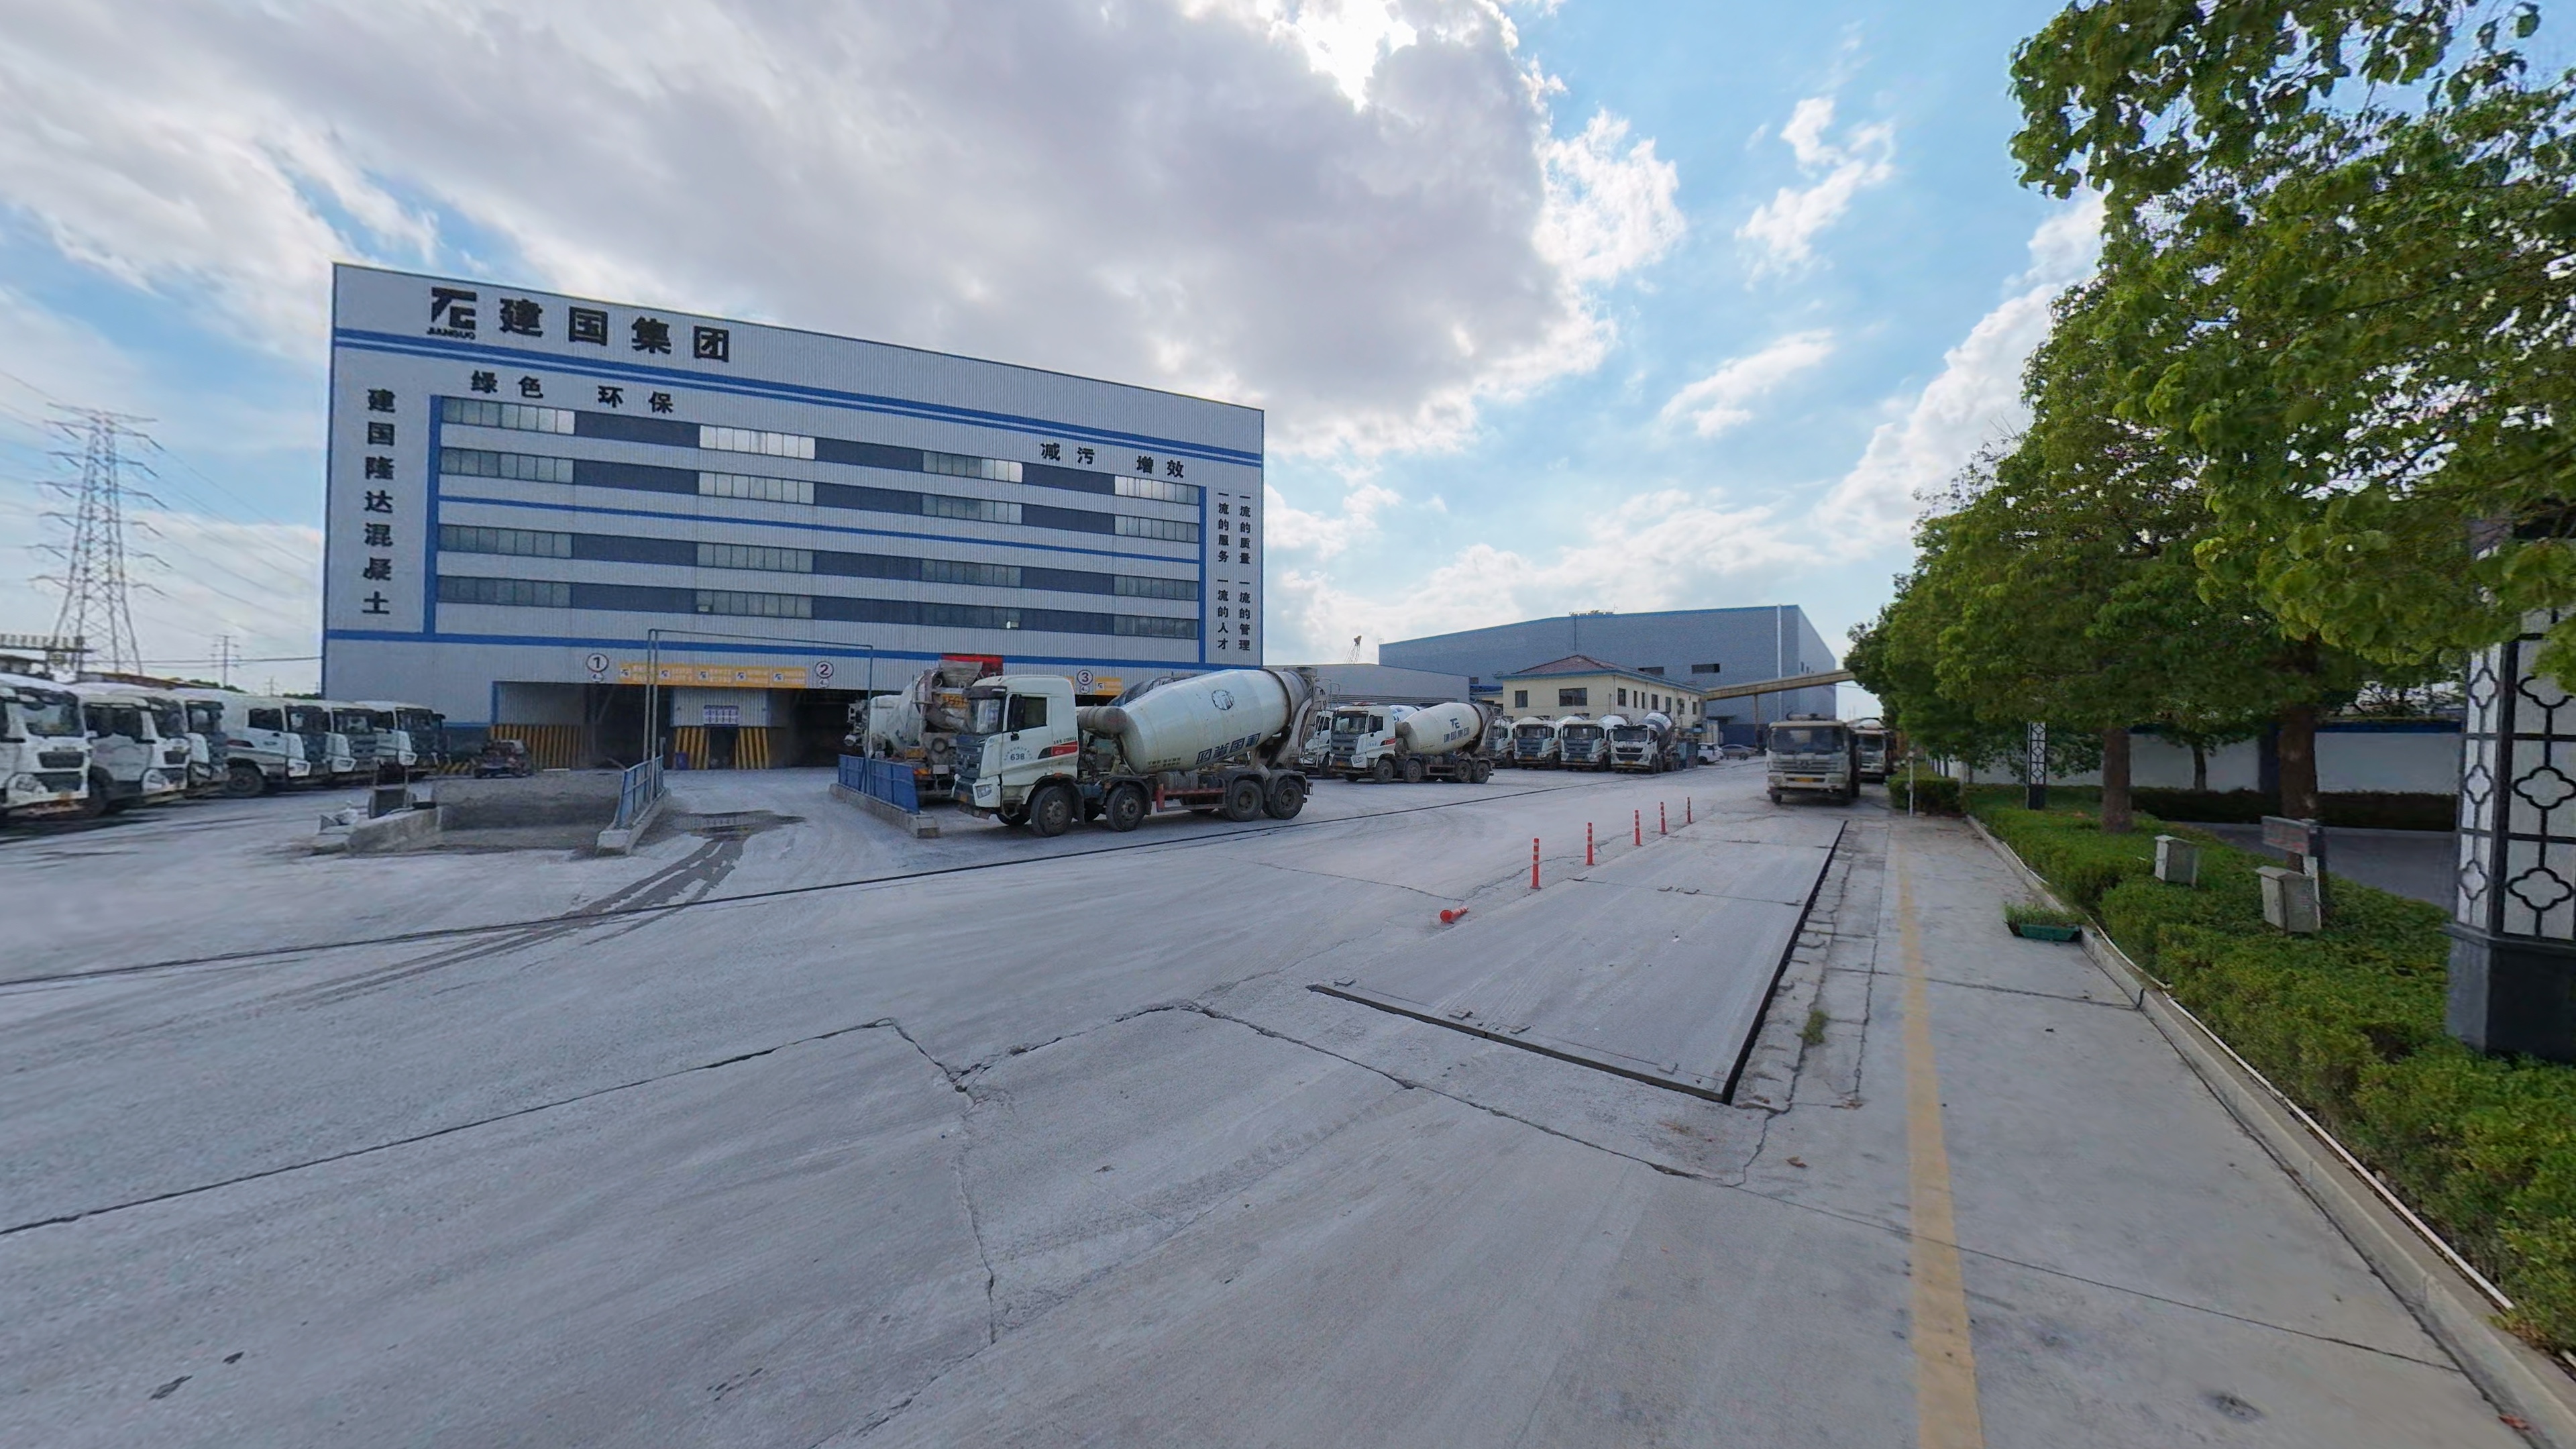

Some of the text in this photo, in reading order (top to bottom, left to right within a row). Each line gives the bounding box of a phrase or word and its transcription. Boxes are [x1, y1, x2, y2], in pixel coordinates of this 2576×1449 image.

[499, 298, 730, 363] 建国集团
[471, 370, 674, 413] 绿色 环保
[1040, 442, 1185, 478] 减污 增效
[1217, 492, 1230, 650] 一流的服务 一流的人才
[1238, 495, 1251, 651] 一流的质量 一流的管理
[1010, 753, 1025, 761] 638
